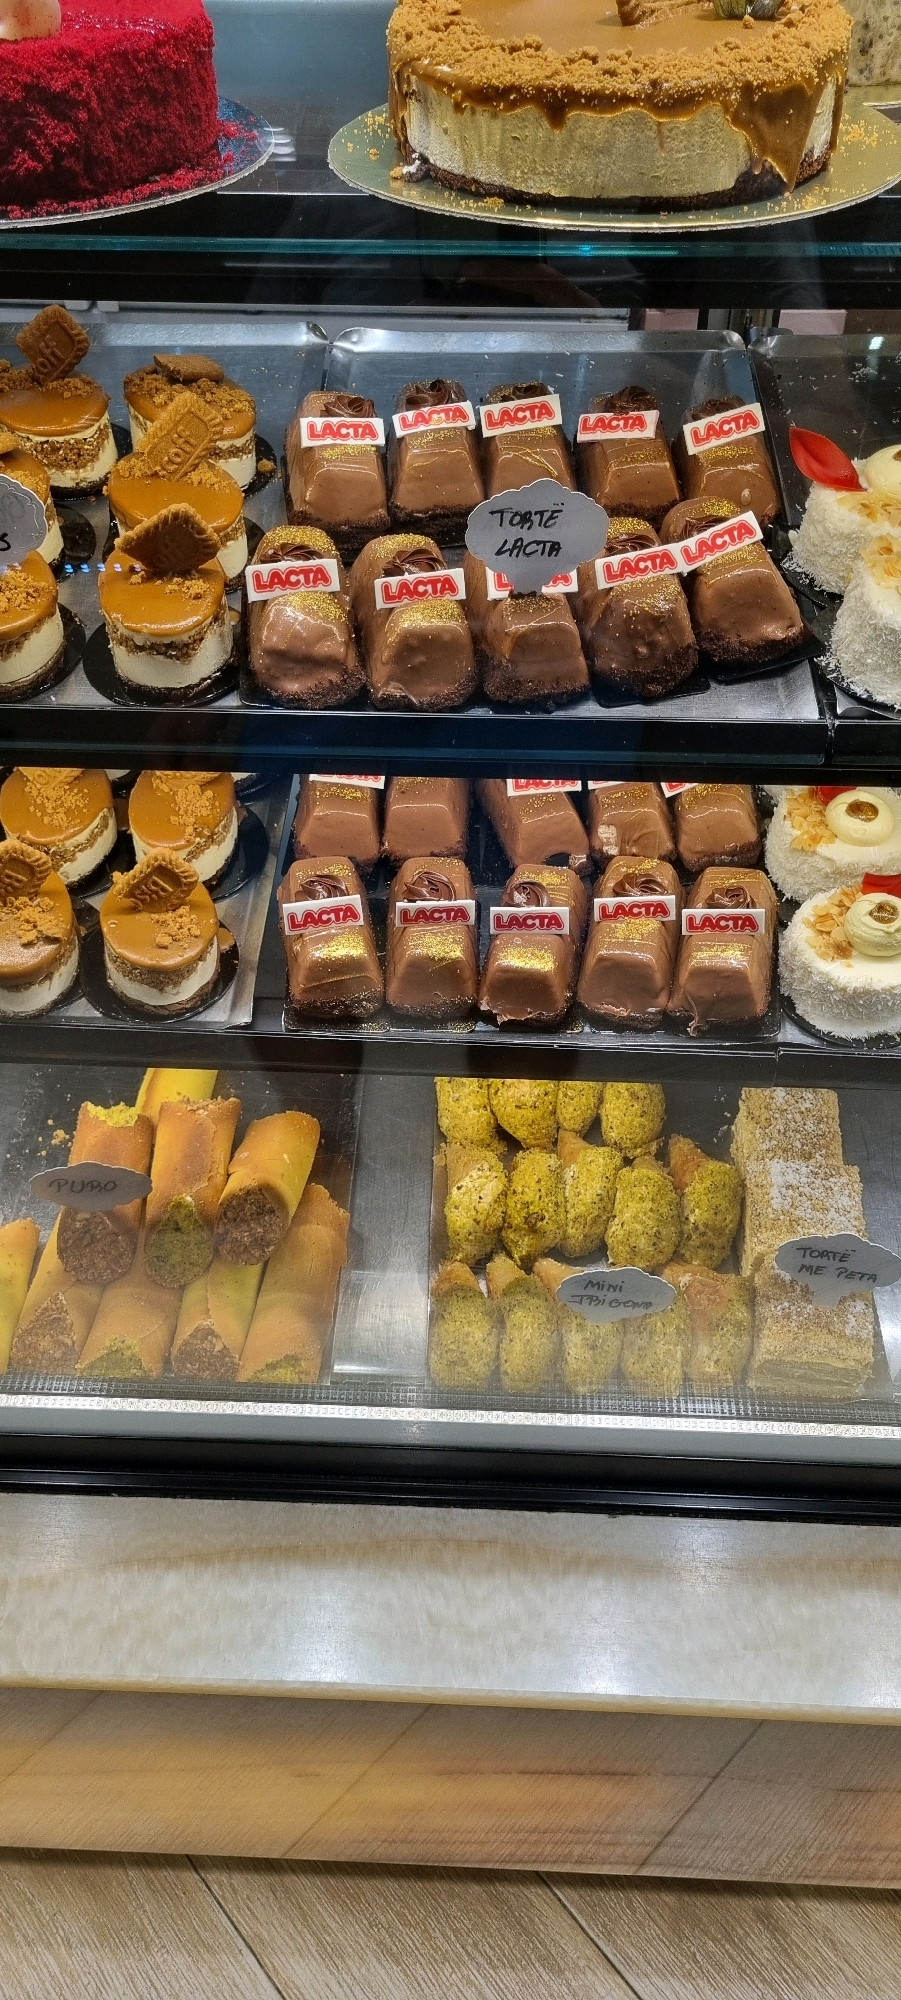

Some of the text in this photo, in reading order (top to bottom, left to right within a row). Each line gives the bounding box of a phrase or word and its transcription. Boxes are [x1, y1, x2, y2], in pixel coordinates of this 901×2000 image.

[399, 404, 469, 431] LACTA
[484, 400, 556, 430] LACTA
[580, 413, 647, 435] LACTA
[307, 421, 379, 441] LACTA
[690, 411, 760, 447] LACTA
[495, 537, 562, 558] LACTA
[681, 519, 757, 566] LACTA
[252, 564, 332, 593] LACTA
[603, 549, 678, 584] LACTA
[381, 574, 459, 604] LACTA
[287, 904, 361, 932] LACTA
[401, 906, 470, 927] LACTA
[494, 912, 564, 932] LACTA
[599, 900, 670, 924] LACTA
[686, 914, 759, 937] LACTA
[798, 1263, 878, 1283] ME PETA
